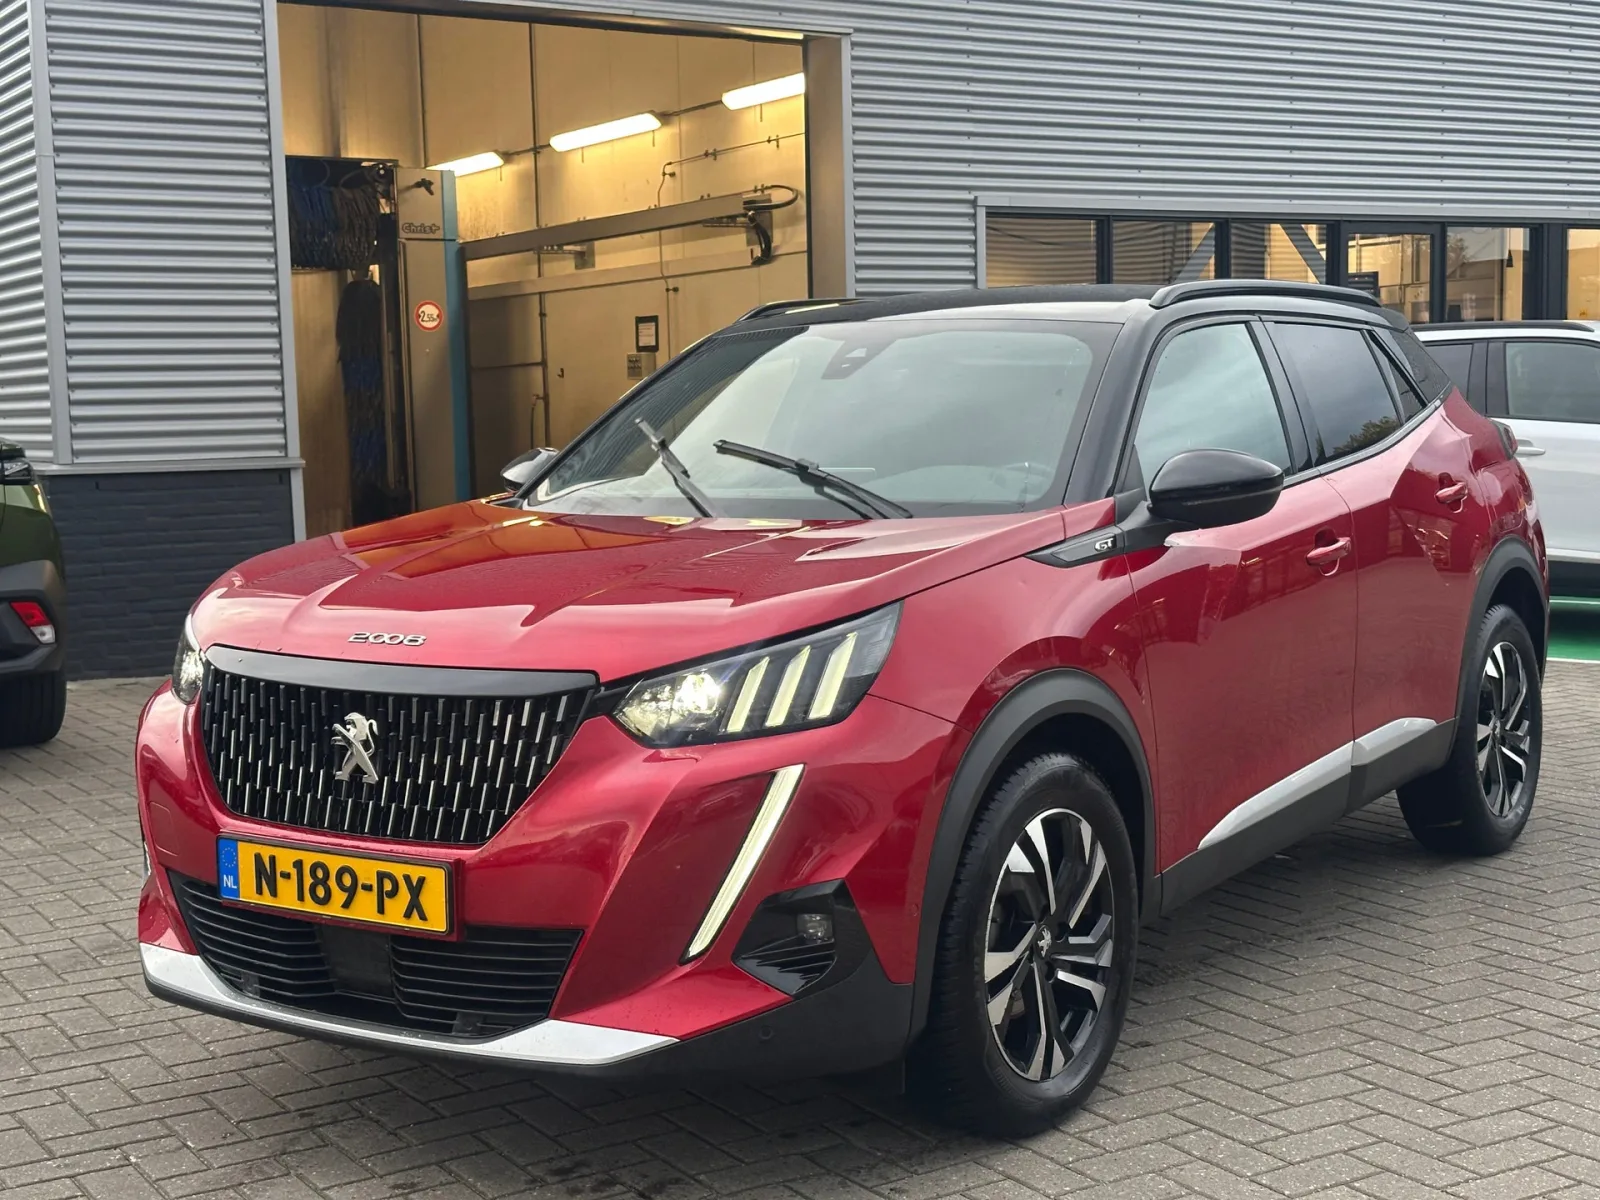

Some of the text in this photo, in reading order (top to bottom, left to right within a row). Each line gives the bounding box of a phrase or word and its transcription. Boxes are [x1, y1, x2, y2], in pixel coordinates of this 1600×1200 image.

[402, 222, 440, 235] Christ
[1095, 538, 1113, 549] GT
[348, 632, 427, 646] 2008
[223, 874, 238, 888] NL
[254, 852, 428, 922] N-189-PX
